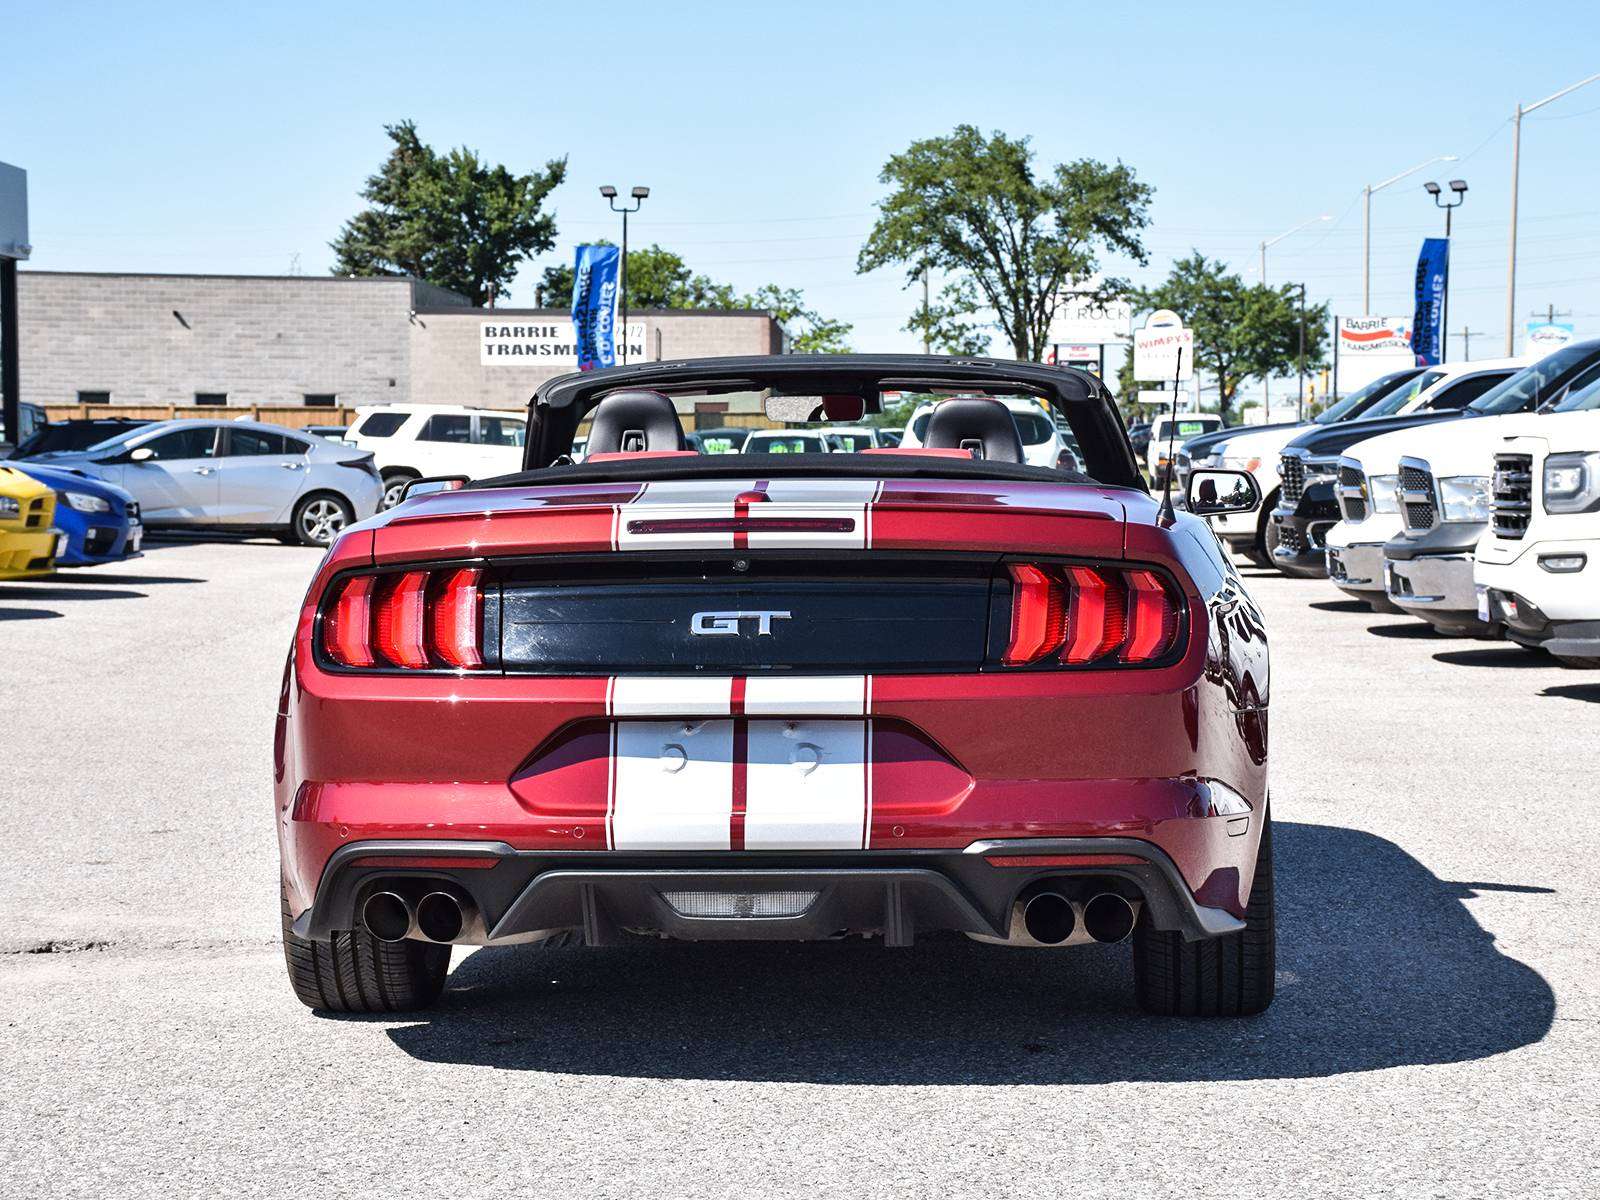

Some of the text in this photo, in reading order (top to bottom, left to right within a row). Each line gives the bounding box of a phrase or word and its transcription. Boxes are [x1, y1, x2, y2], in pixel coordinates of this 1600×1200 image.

[1077, 307, 1128, 321] ROCK
[1346, 317, 1388, 330] BARRIE
[484, 326, 560, 338] BARRIE
[484, 343, 643, 356] TRANSMION
[690, 610, 792, 636] GT
